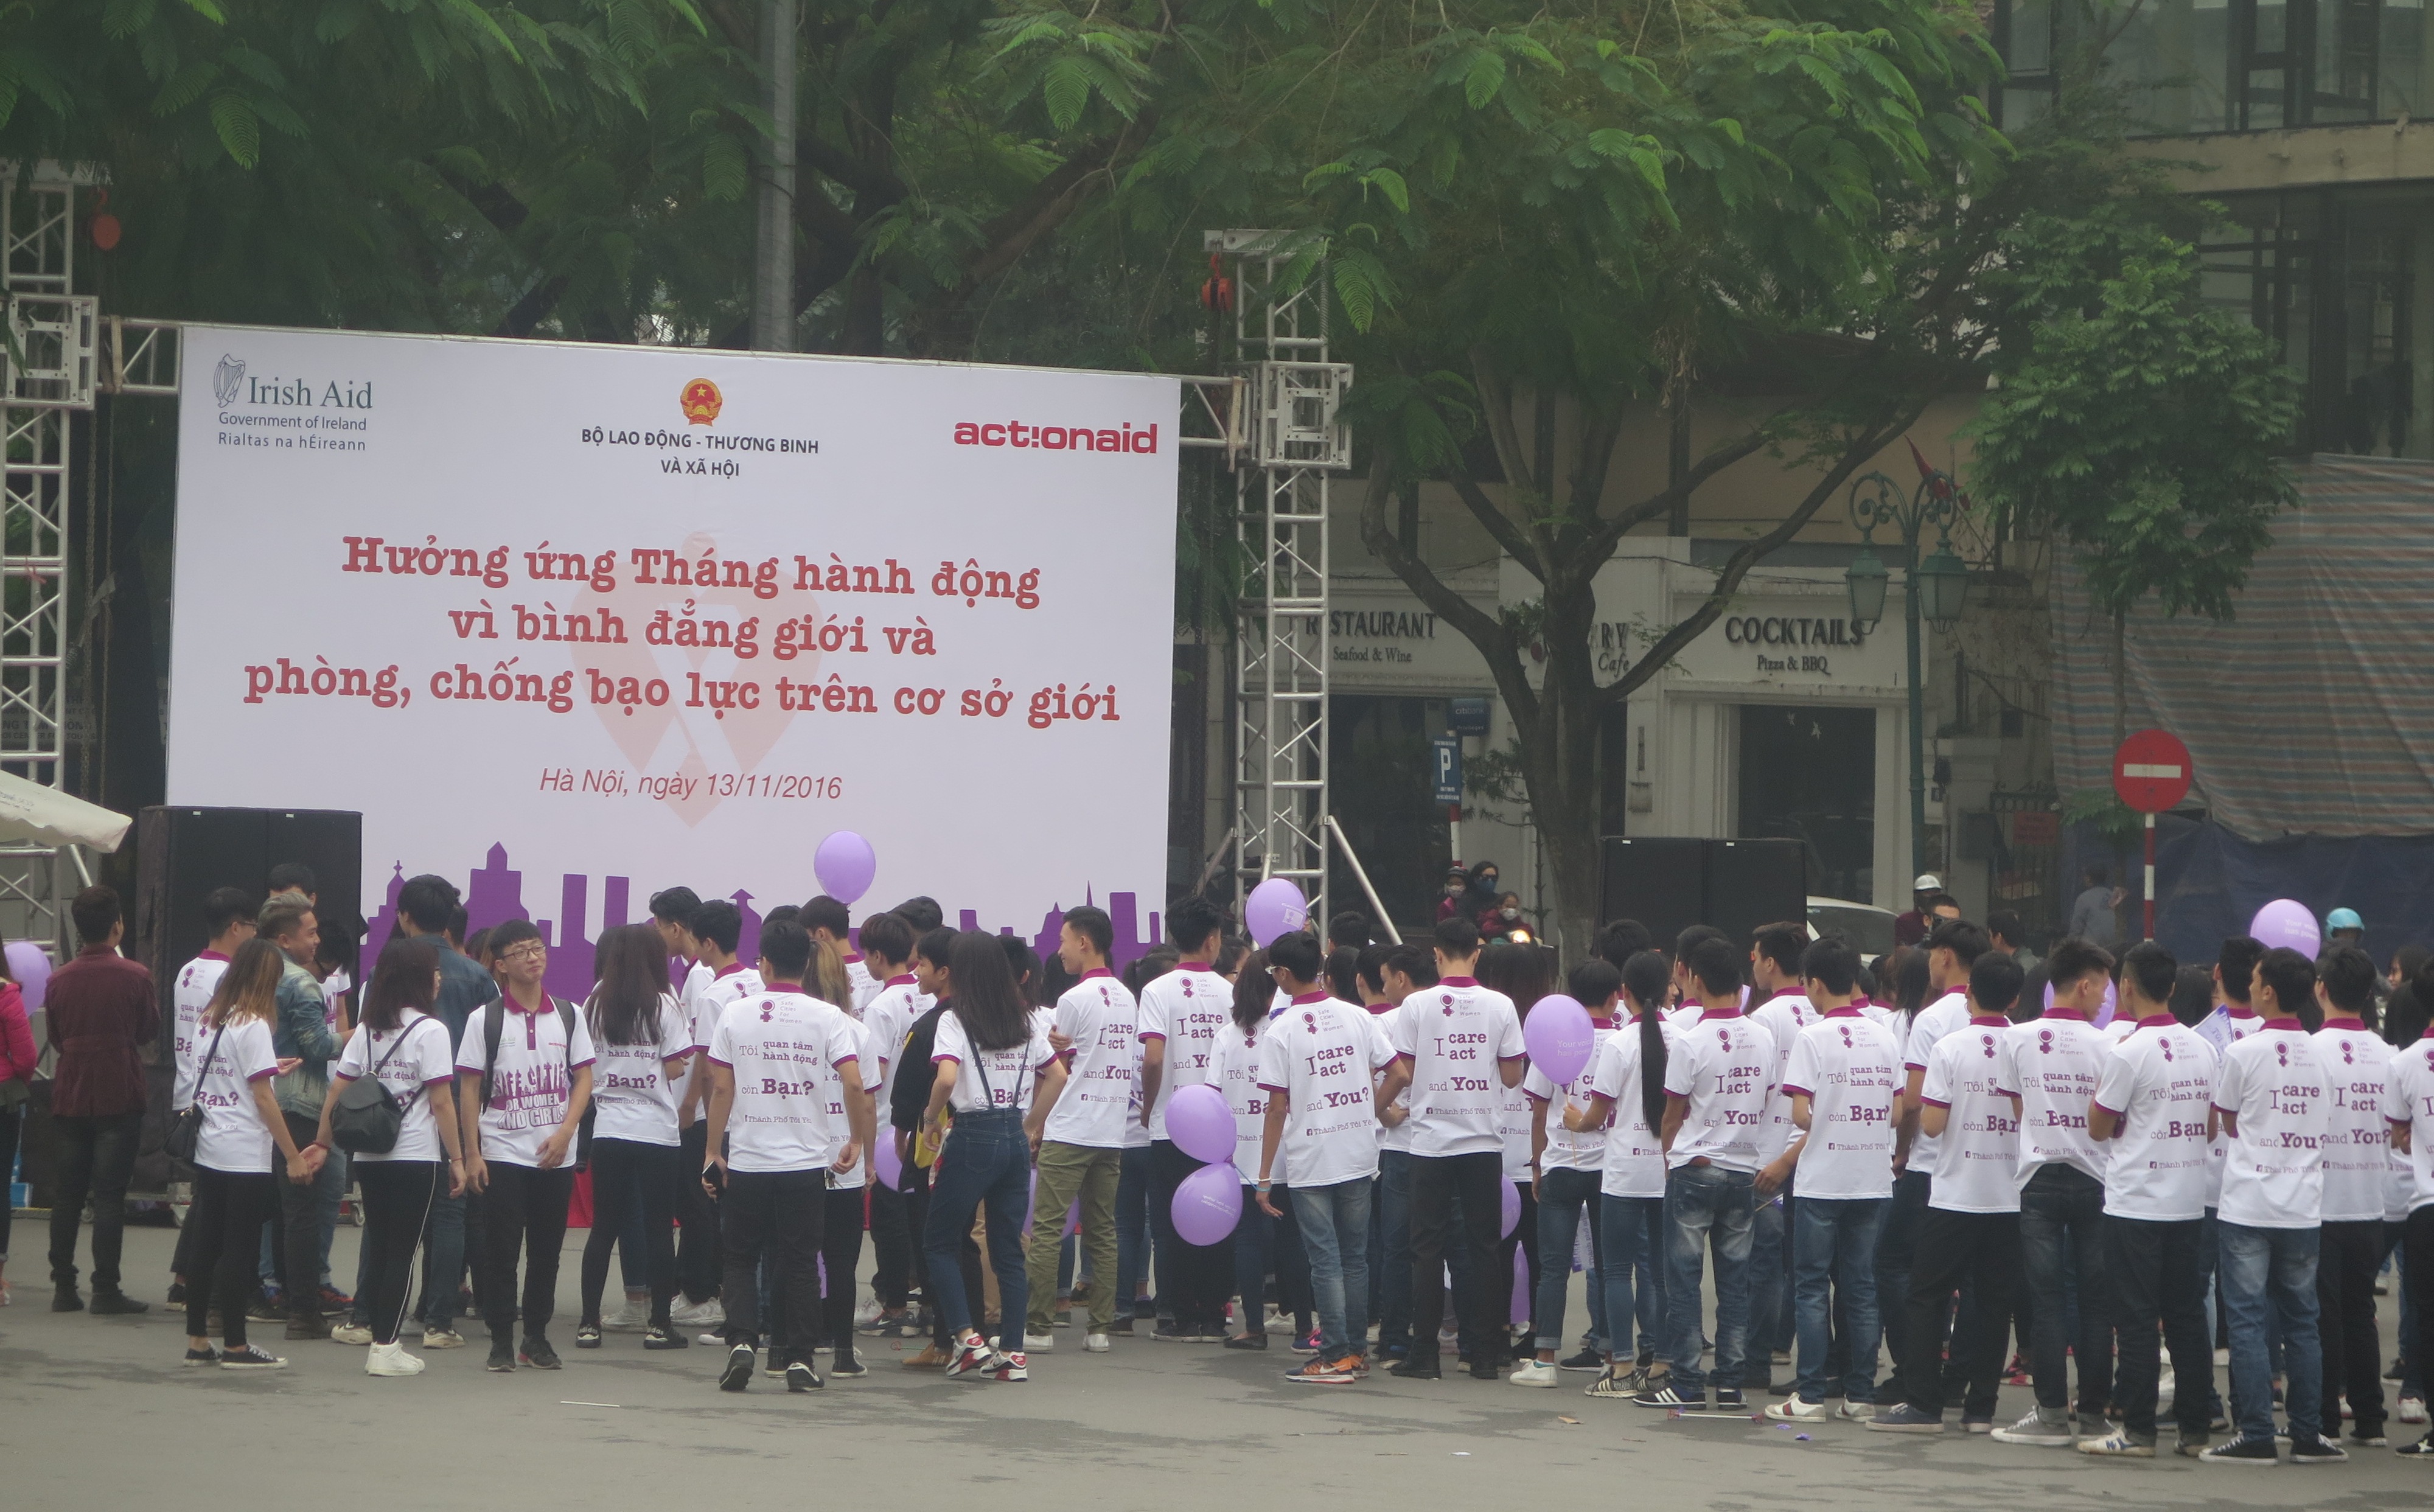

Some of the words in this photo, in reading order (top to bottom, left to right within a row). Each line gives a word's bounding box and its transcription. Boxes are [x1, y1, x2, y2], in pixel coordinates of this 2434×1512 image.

[248, 376, 312, 408] Irish
[320, 381, 373, 409] Aid
[219, 411, 302, 429] Government
[305, 415, 319, 429] of
[321, 416, 367, 431] Ireland
[218, 431, 270, 448] Rialtas
[275, 437, 293, 448] na
[298, 433, 366, 451] hÉireann
[581, 425, 604, 446] BỘ
[609, 430, 640, 446] LAO
[644, 427, 692, 451] ĐỘNG
[705, 434, 776, 453] THƯƠNG
[781, 438, 819, 455] BINH
[661, 458, 682, 475] VÀ
[686, 456, 707, 476] XÃ
[711, 459, 739, 479] HỘI
[342, 534, 509, 589] Hưởng
[525, 540, 616, 593] ứng
[632, 547, 779, 599] Tháng
[793, 552, 915, 594] hành
[931, 558, 1040, 610] động
[448, 599, 498, 639] vì
[512, 601, 628, 644] bình
[644, 599, 758, 660] đẳng
[773, 613, 868, 661] giới
[883, 615, 936, 656] và
[1306, 610, 1437, 639] RSTAURANT
[1725, 617, 1866, 645] COCKTAILS
[1333, 646, 1369, 662] Seafood
[1373, 648, 1383, 661] &
[1385, 648, 1412, 663] Wine
[1757, 655, 1784, 670] Pizza
[1788, 656, 1798, 670] &
[1802, 656, 1830, 675] BBQ
[243, 654, 411, 709] phòng,
[430, 656, 574, 714] chống
[585, 667, 669, 717] bạo
[685, 672, 760, 720] lực
[775, 672, 877, 713] trên
[894, 687, 945, 716] cơ
[961, 677, 1013, 717] sở
[1028, 682, 1120, 729] giới
[1440, 748, 1451, 783] P
[540, 767, 574, 792] Hà
[582, 768, 629, 798] Nội,
[637, 772, 697, 801] ngày
[707, 773, 842, 800] 13/11/2016
[1190, 1013, 1223, 1024] care
[1108, 1023, 1133, 1034] care
[1177, 1019, 1188, 1036] I
[1191, 1028, 1215, 1039] act
[1097, 1028, 1107, 1046] I
[1108, 1039, 1125, 1049] act
[1448, 1033, 1487, 1043] care
[739, 1045, 758, 1056] Tôi
[763, 1042, 789, 1050] quan
[793, 1041, 813, 1051] tâm
[1317, 1045, 1355, 1061] care
[1434, 1038, 1445, 1056] I
[763, 1052, 790, 1061] hành
[793, 1054, 818, 1065] động
[1449, 1047, 1476, 1060] act
[1173, 1059, 1191, 1070] and
[1305, 1056, 1317, 1076] I
[1320, 1061, 1347, 1077] act
[1850, 1067, 1873, 1075] quan
[1083, 1069, 1105, 1079] and
[1227, 1069, 1245, 1081] Tôi
[1728, 1066, 1760, 1079] care
[1827, 1072, 1847, 1084] Tôi
[2043, 1073, 2071, 1081] quan
[761, 1078, 814, 1099] Bạn?
[1429, 1081, 1448, 1091] and
[1715, 1075, 1726, 1095] I
[1727, 1083, 1751, 1095] act
[1850, 1078, 1875, 1086] hành
[1964, 1081, 1985, 1092] Tôi
[2023, 1077, 2040, 1088] Tôi
[2044, 1084, 2072, 1094] hành
[741, 1085, 759, 1095] còn
[2282, 1085, 2320, 1098] care
[2335, 1087, 2346, 1107] I
[506, 1098, 520, 1112] OR
[521, 1093, 559, 1110] WOMEN
[1323, 1086, 1369, 1109] You?
[2269, 1090, 2281, 1110] I
[2282, 1101, 2307, 1115] act
[2351, 1098, 2376, 1112] act
[529, 1106, 565, 1127] GIRLS
[1829, 1112, 1847, 1122] còn
[1314, 1125, 1336, 1135] Thành
[1963, 1122, 1984, 1131] còn
[2169, 1121, 2206, 1143] Bạn
